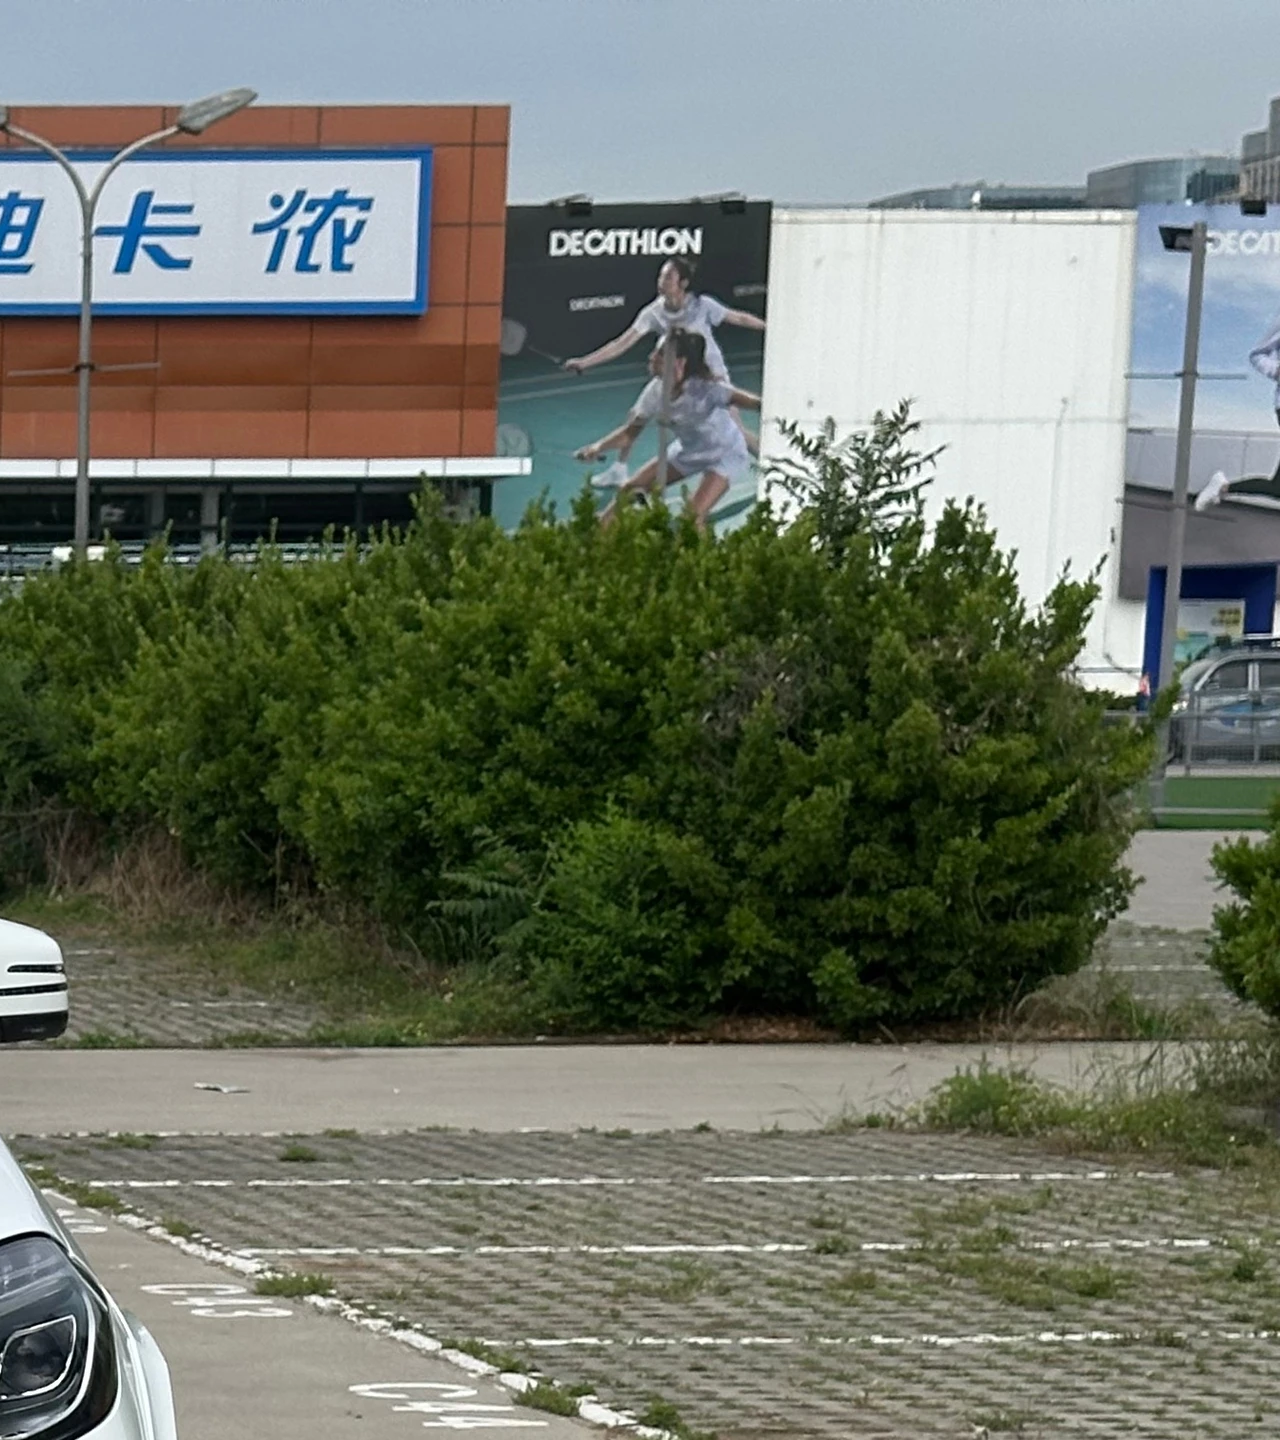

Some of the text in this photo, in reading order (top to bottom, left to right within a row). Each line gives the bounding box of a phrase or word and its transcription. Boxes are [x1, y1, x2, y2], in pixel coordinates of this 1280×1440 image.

[549, 227, 704, 257] DECATHLON
[139, 1282, 294, 1318] C43
[347, 1382, 550, 1429] C44
